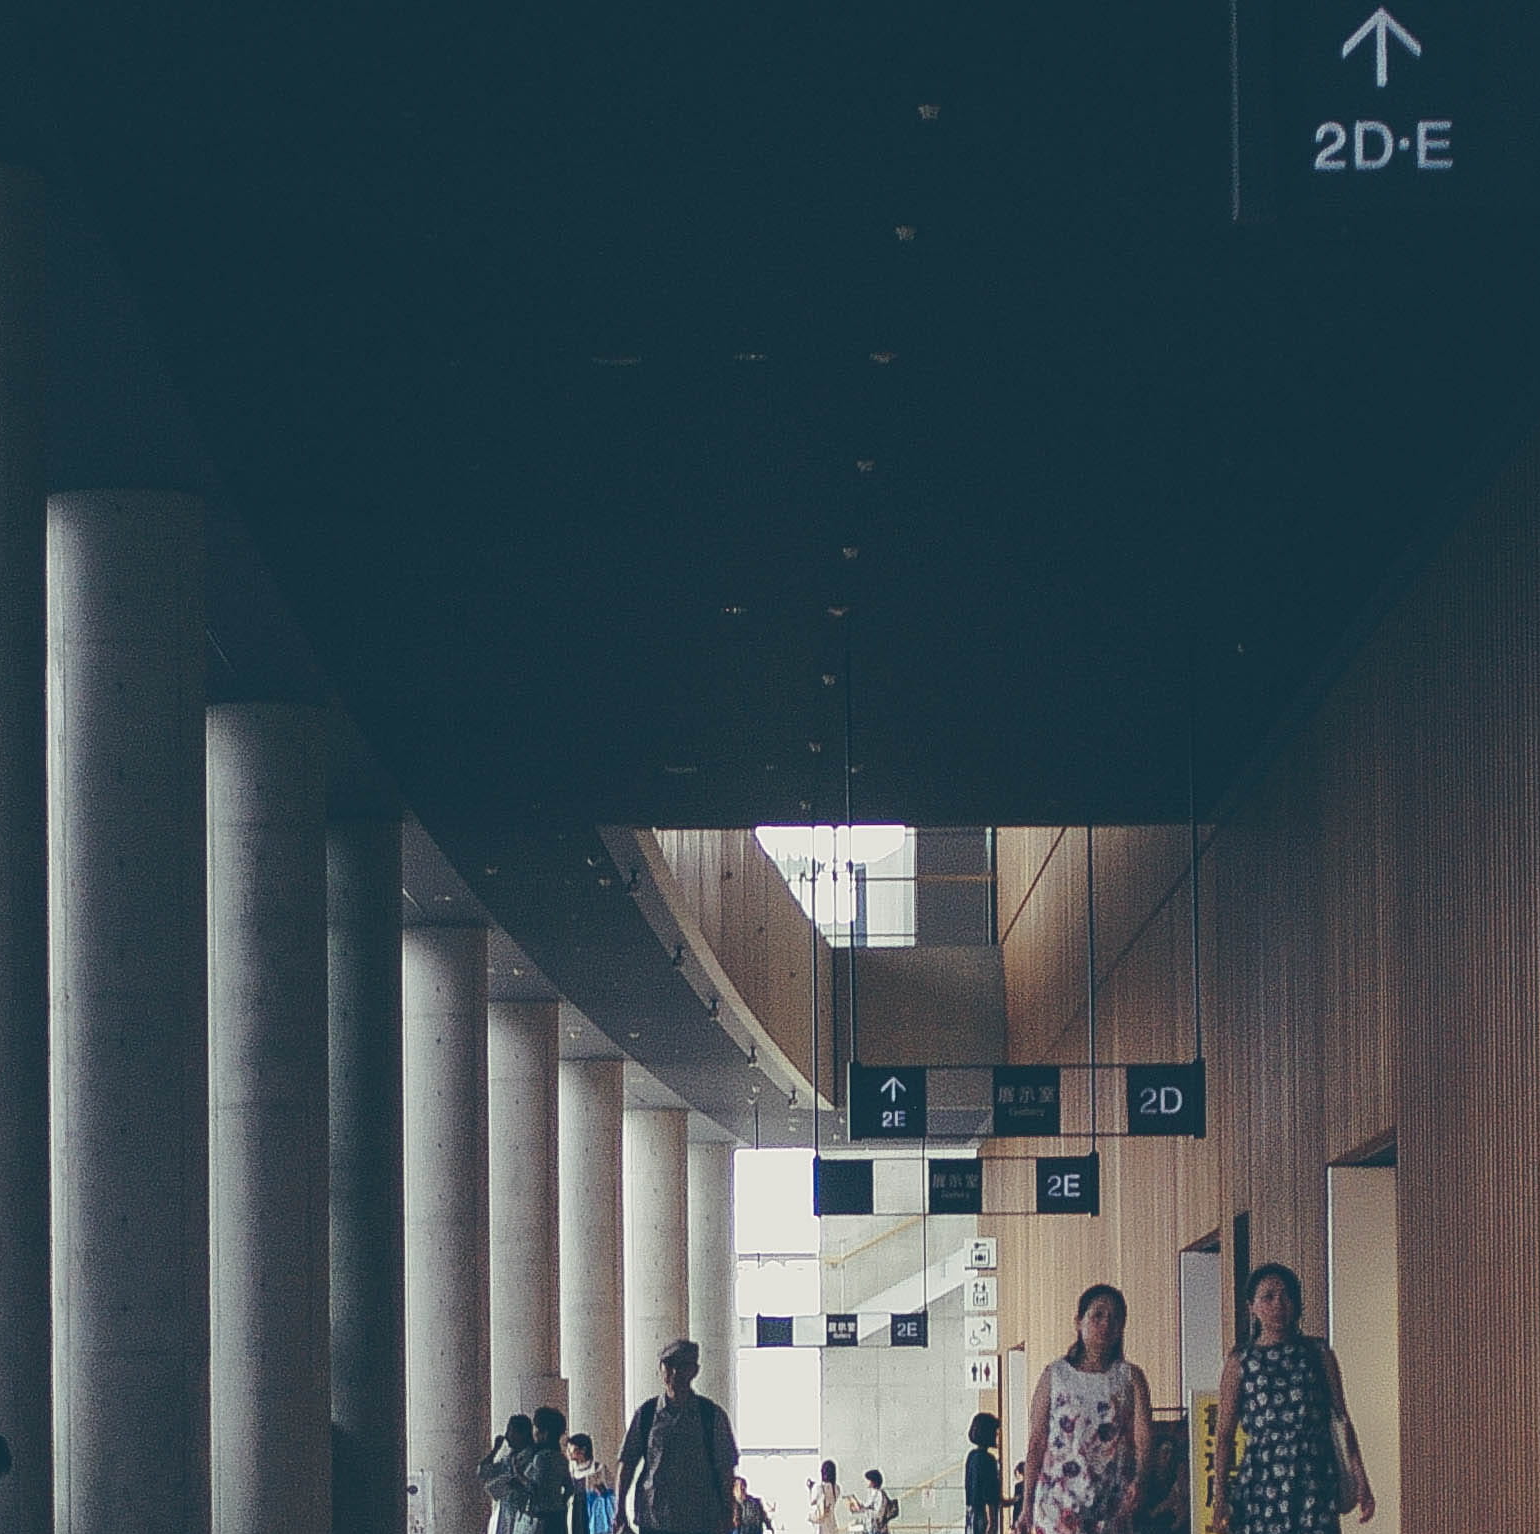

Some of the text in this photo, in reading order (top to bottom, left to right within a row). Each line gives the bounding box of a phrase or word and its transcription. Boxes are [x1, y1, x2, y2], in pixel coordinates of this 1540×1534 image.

[1140, 1086, 1183, 1114] 2D
[881, 1110, 906, 1128] 2E
[1047, 1173, 1081, 1198] 2E
[896, 1321, 918, 1338] 2E
